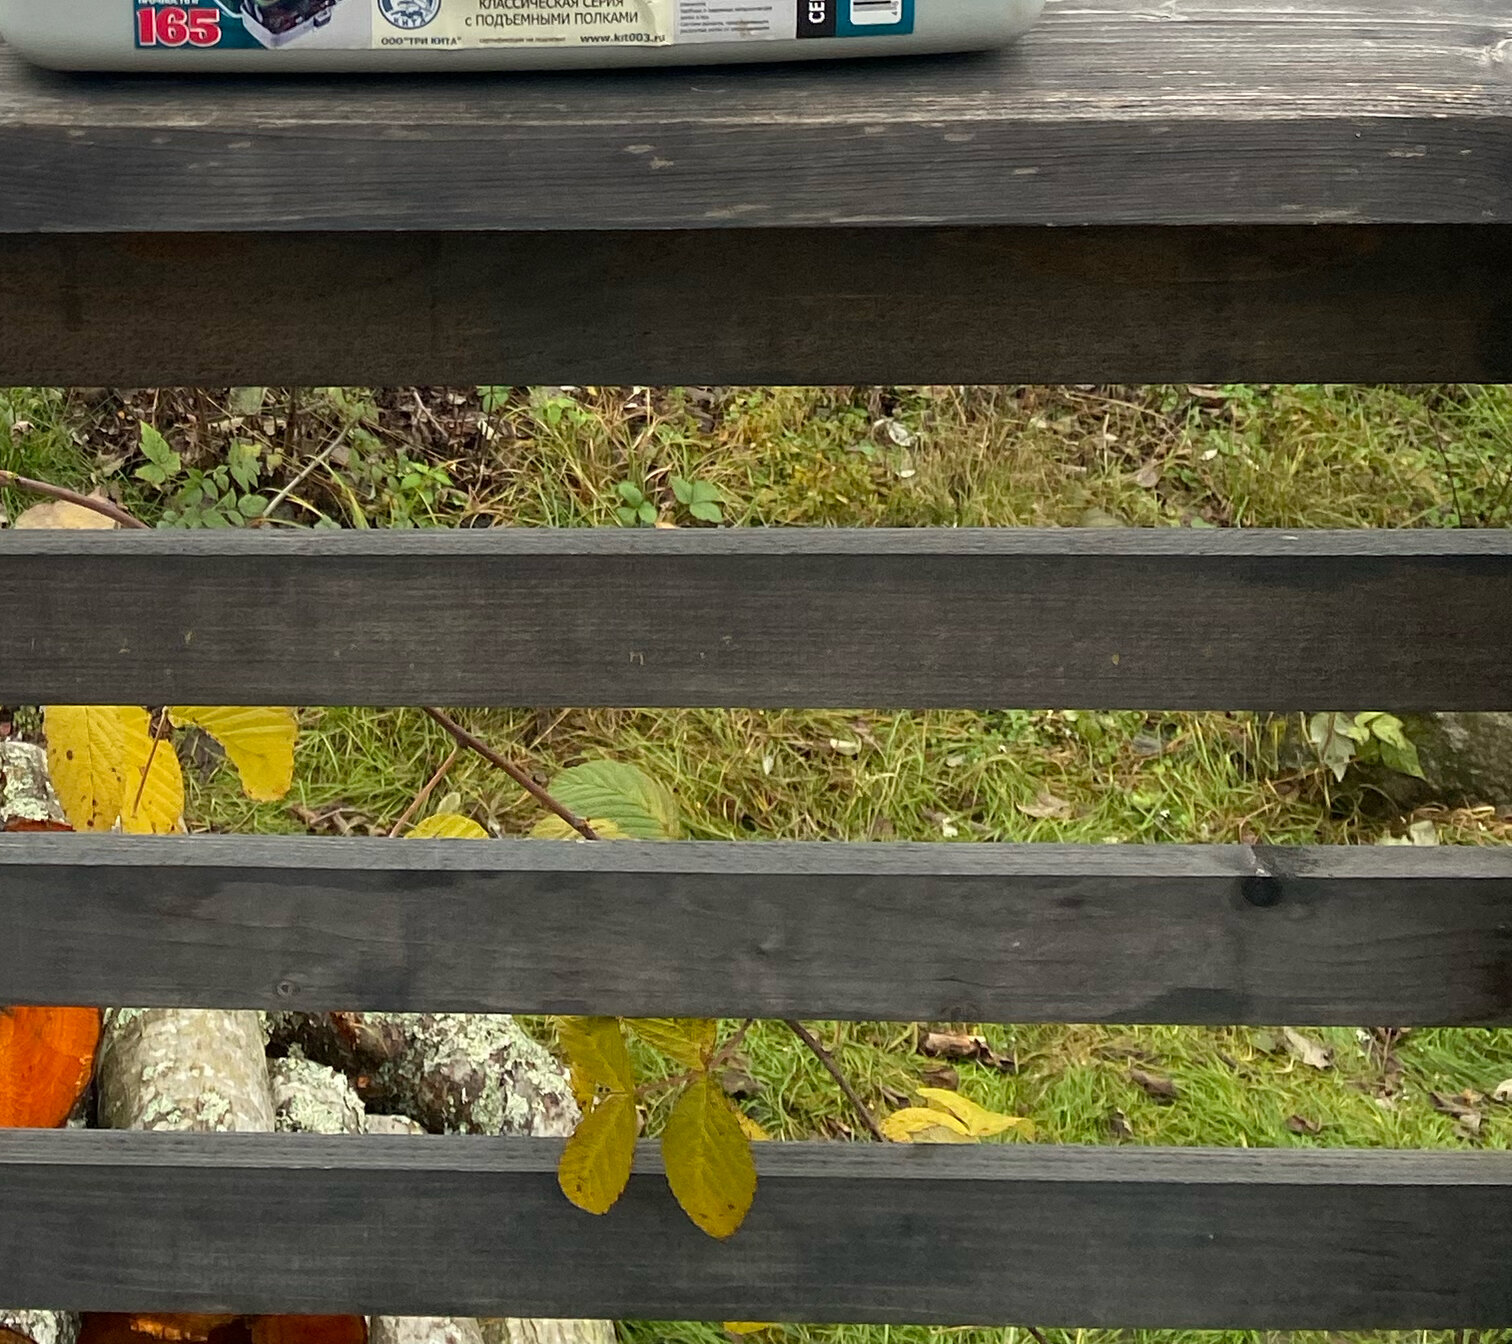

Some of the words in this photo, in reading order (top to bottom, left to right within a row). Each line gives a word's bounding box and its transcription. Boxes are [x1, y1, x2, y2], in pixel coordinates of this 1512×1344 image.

[137, 6, 222, 48] 165
[475, 13, 570, 30] ПОДЪЕМНЫМИ
[574, 11, 639, 25] ПОЛКАМИ
[580, 33, 666, 45] www.kit003.ru
